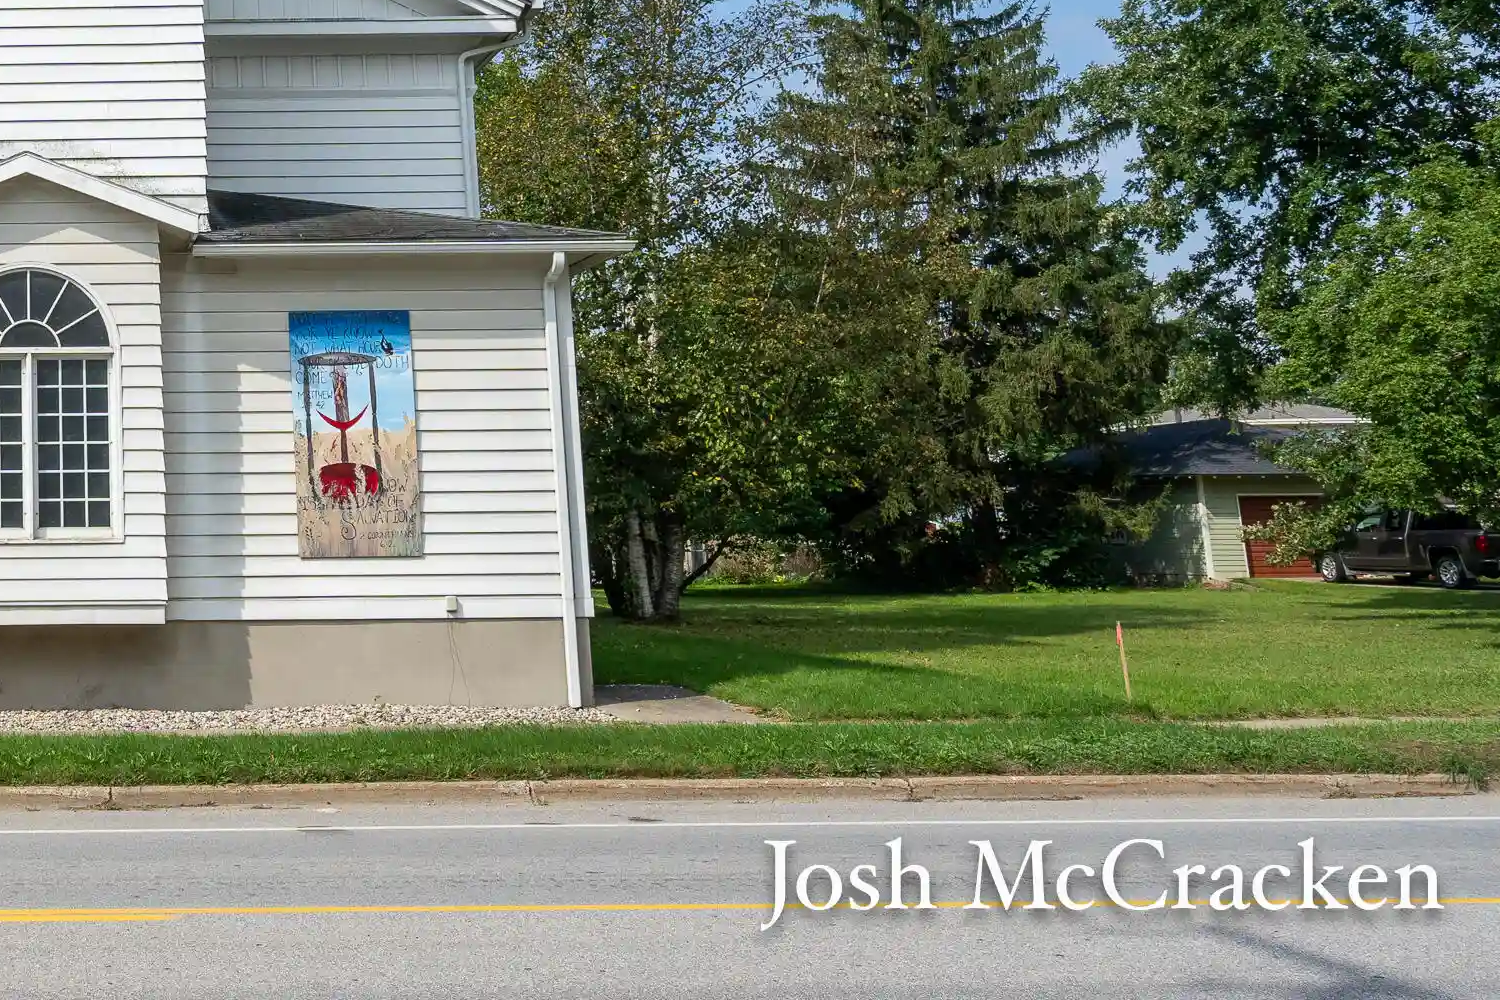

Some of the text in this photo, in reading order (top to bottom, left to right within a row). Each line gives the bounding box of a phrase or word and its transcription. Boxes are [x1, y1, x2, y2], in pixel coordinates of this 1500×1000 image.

[294, 341, 316, 355] NOT
[324, 340, 352, 355] WHAT
[375, 354, 409, 370] DOTH
